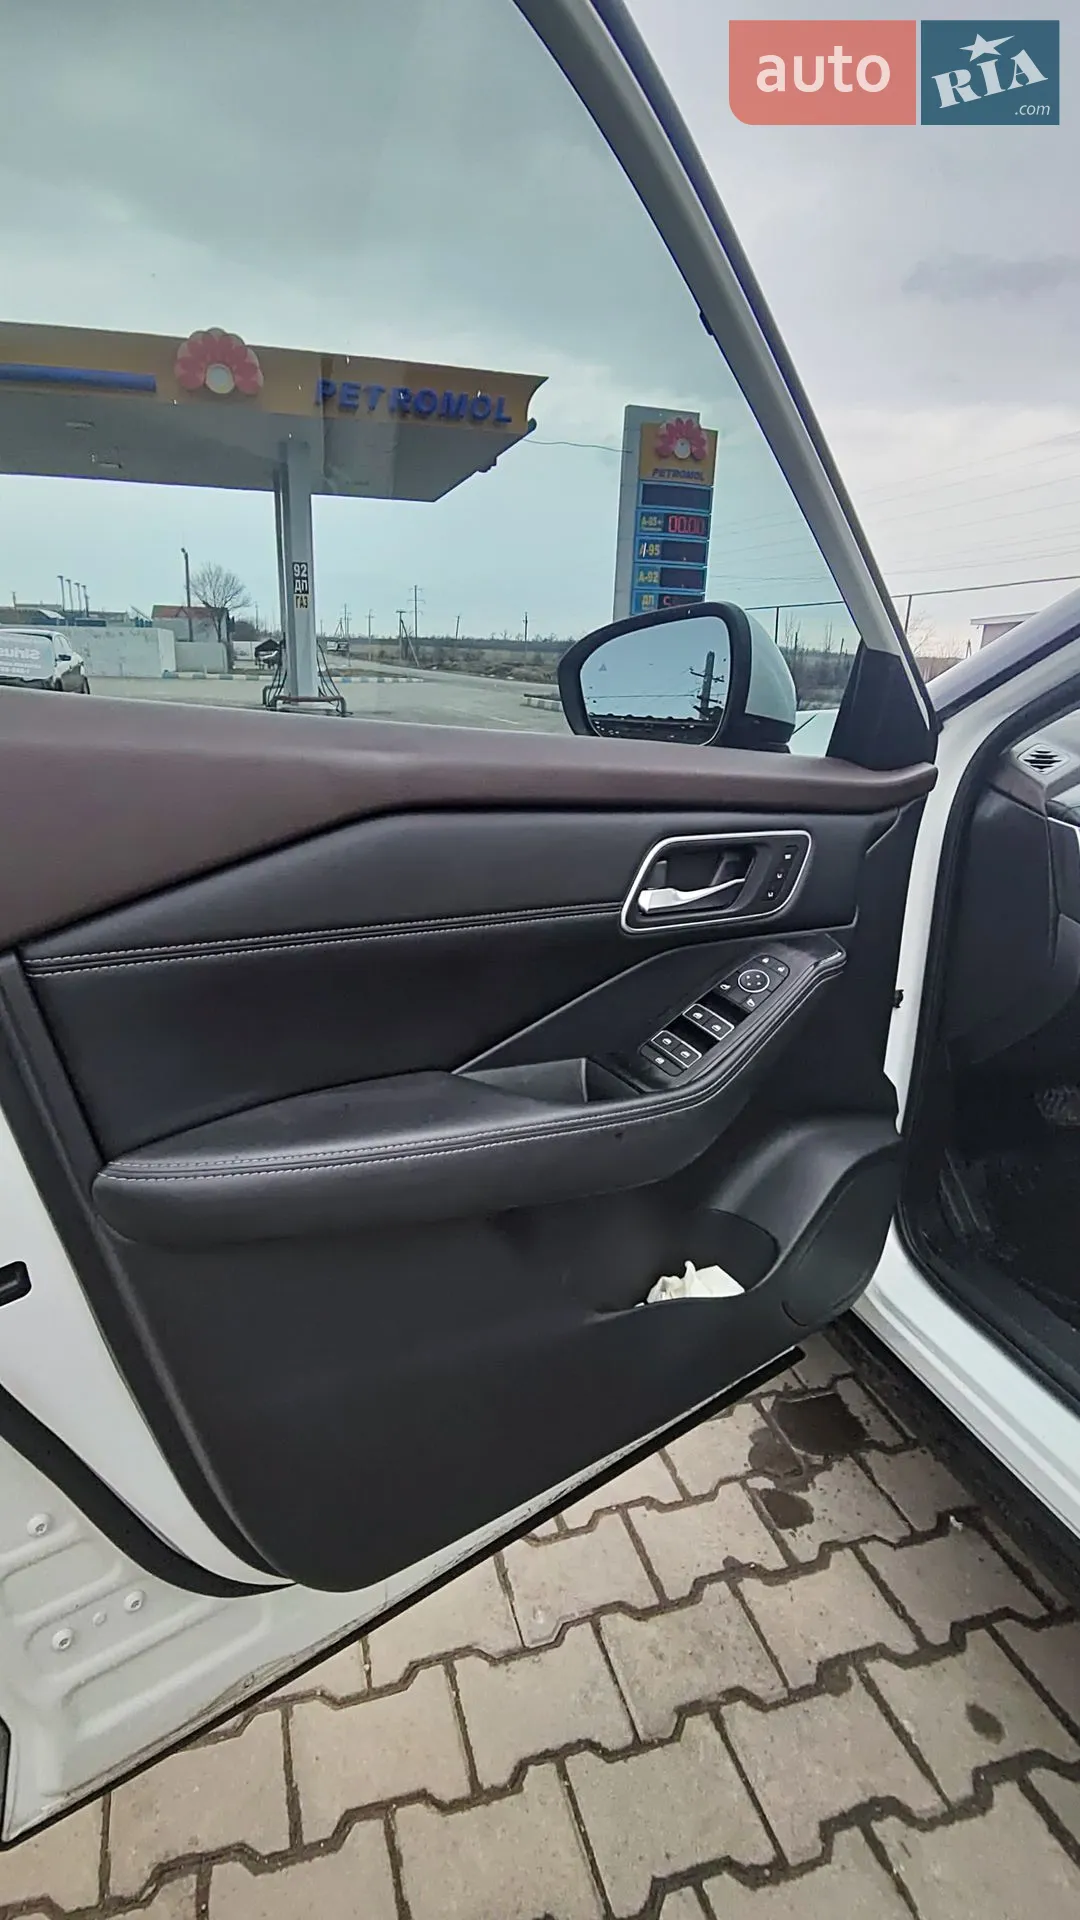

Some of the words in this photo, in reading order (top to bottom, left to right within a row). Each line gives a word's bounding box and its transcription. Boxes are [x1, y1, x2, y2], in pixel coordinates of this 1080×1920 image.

[314, 377, 513, 424] PETROMOL
[652, 467, 704, 482] PETROMOL
[293, 563, 307, 578] 92
[295, 595, 308, 609] ГАЗ
